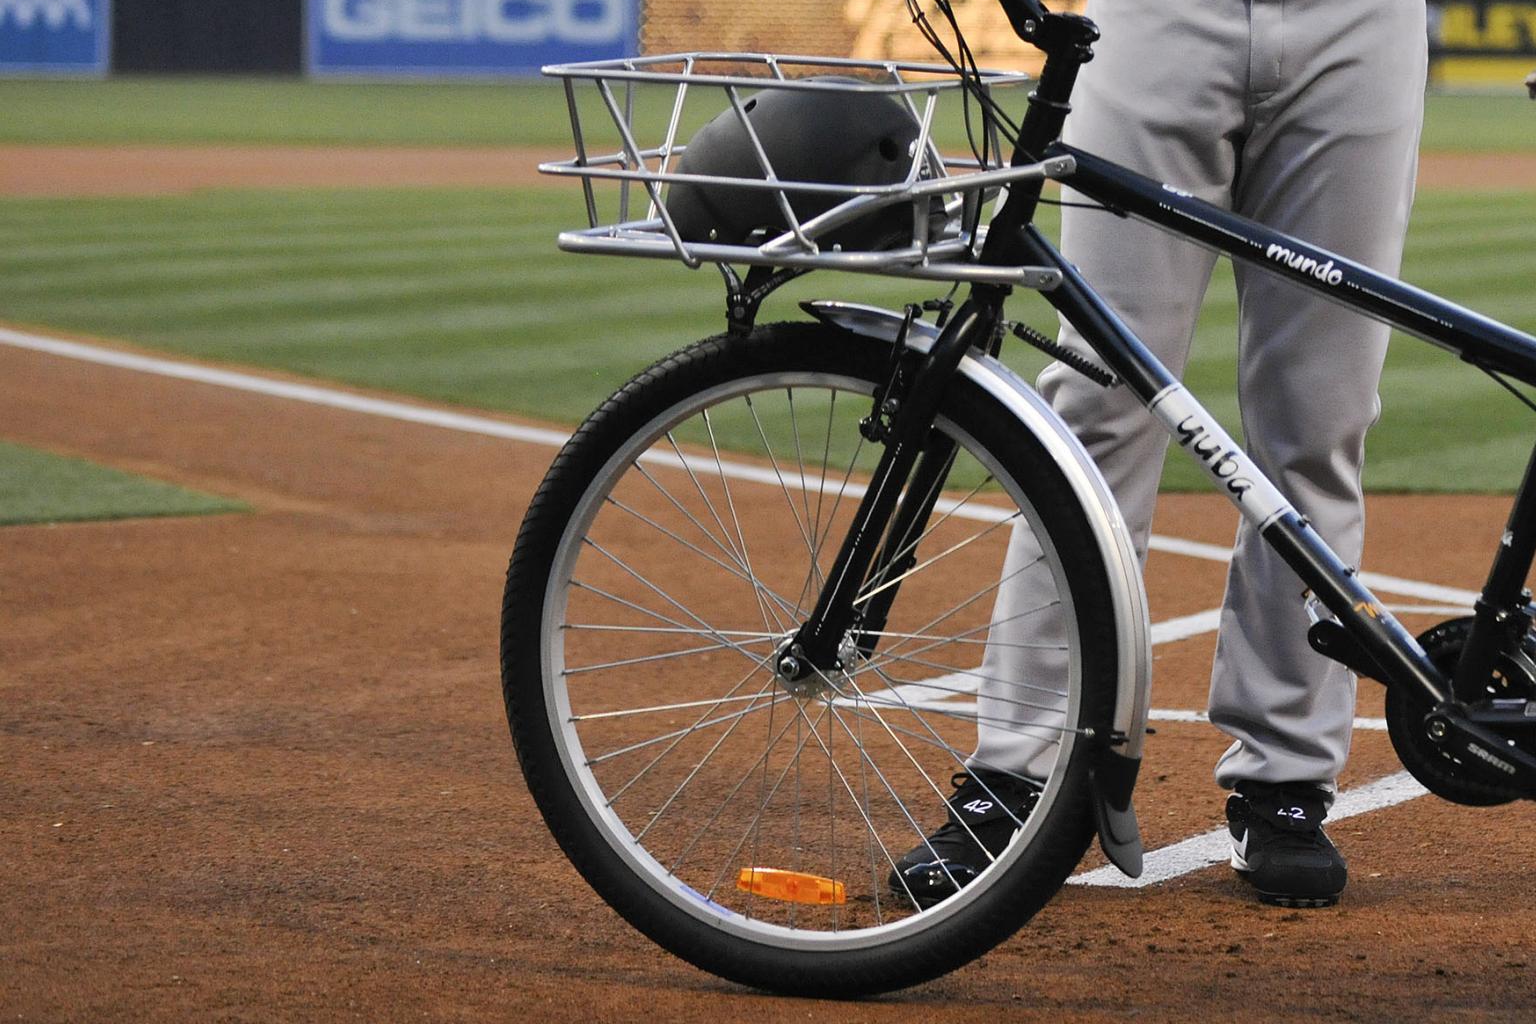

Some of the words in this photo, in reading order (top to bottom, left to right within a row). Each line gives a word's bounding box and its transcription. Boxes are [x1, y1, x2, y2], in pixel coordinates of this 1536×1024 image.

[1265, 240, 1344, 286] mundo
[1175, 414, 1256, 503] yuba
[962, 798, 994, 815] 42
